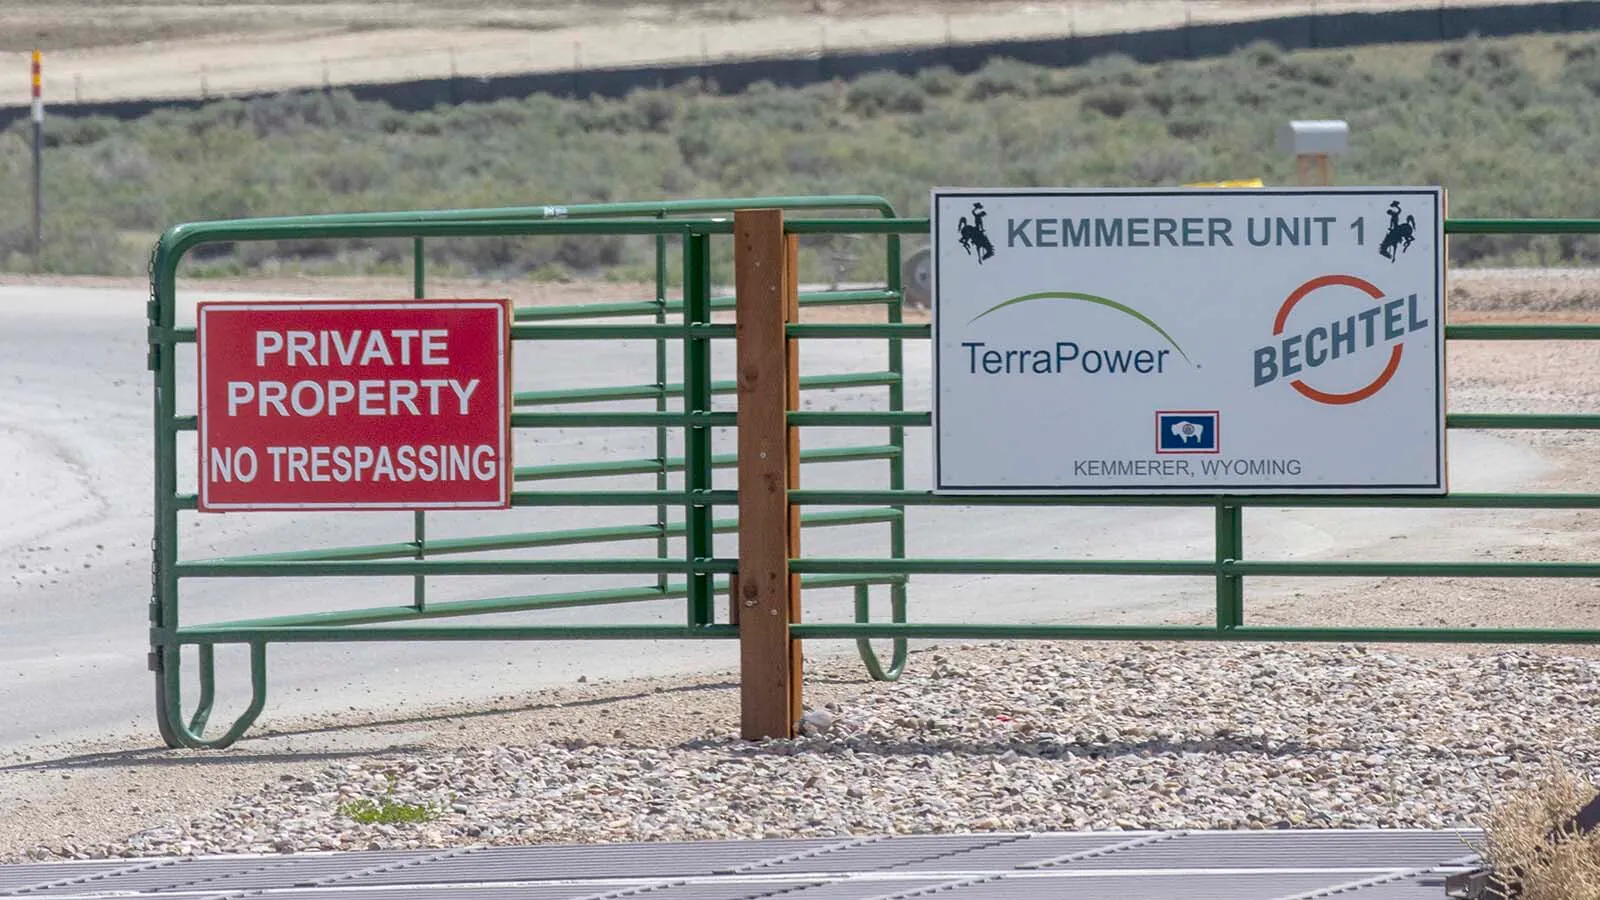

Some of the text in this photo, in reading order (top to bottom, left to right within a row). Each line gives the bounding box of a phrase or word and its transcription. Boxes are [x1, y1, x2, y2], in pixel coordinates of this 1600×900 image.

[1007, 215, 1366, 248] KEMMERER UNIT 1
[255, 329, 449, 367] PRIVATE
[961, 341, 1170, 374] TerraPower
[1253, 293, 1429, 388] BECHTEL
[227, 379, 480, 417] PROPERTY
[211, 444, 497, 483] NO TRESPASSING
[1074, 458, 1302, 477] KEMMERER, WYOMING
